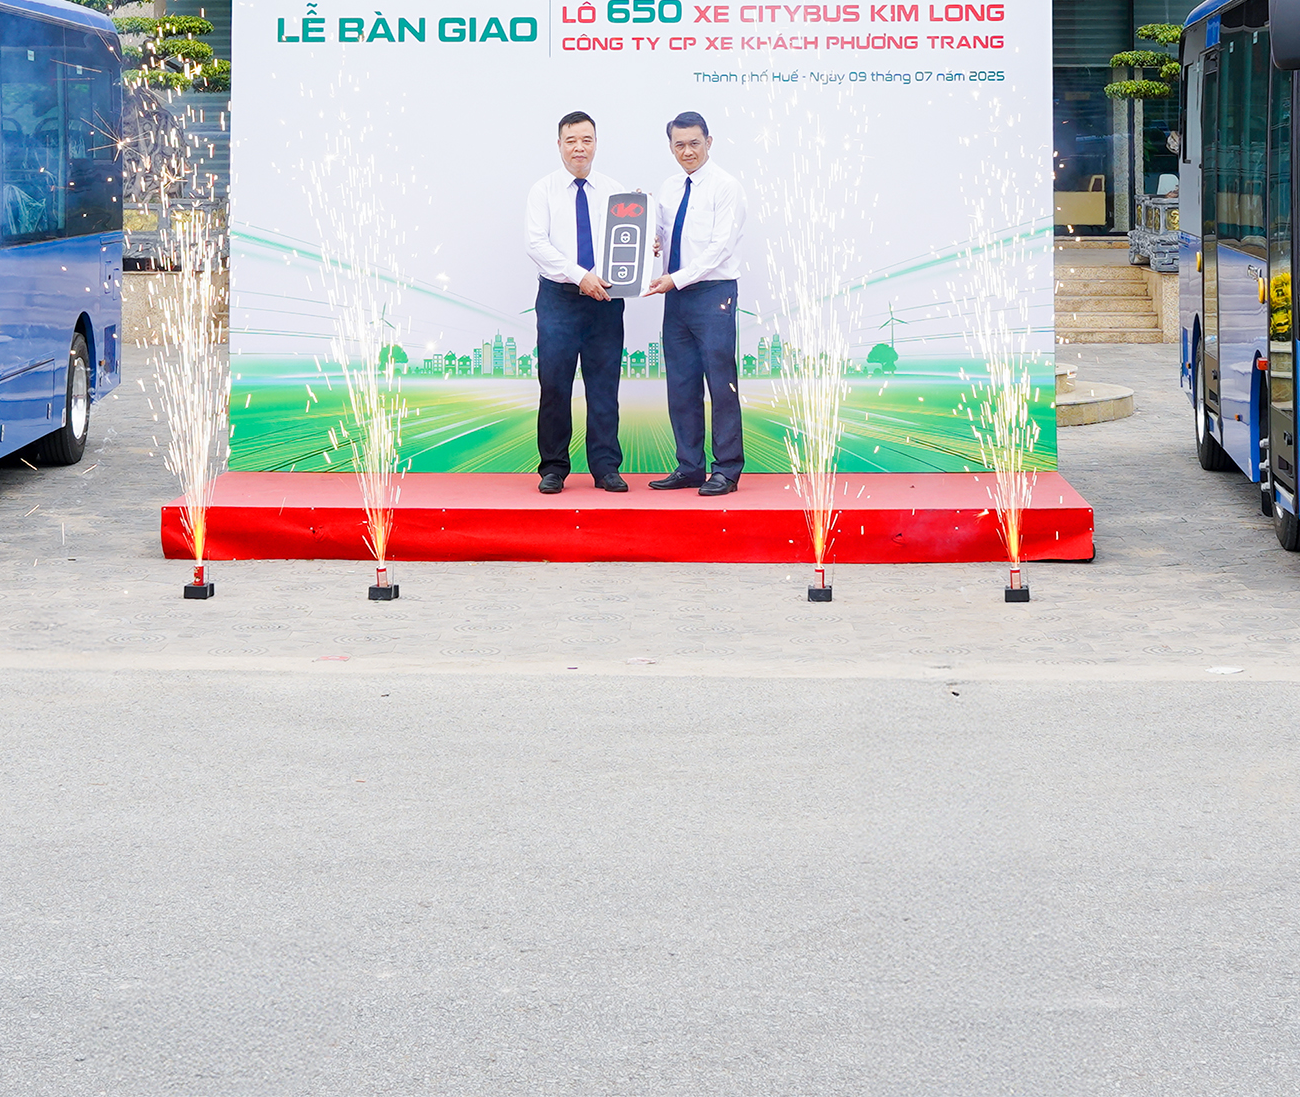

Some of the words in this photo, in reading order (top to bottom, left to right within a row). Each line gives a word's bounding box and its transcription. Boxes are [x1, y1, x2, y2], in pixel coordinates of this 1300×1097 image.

[562, 1, 597, 23] LÔ
[607, 0, 683, 24] 650
[693, 5, 730, 23] XE
[740, 4, 860, 23] CITYBUS
[870, 4, 919, 22] KIM
[929, 4, 1005, 22] LONG
[277, 2, 326, 43] LỄ
[338, 10, 426, 43] BÀN
[438, 16, 538, 43] GIAO
[562, 33, 624, 50] CÔNG
[631, 37, 661, 50] TY
[669, 37, 697, 50] CP
[705, 36, 733, 50] XE
[741, 33, 818, 50] KHÁCH
[826, 33, 919, 50] PHƯƠNG
[926, 35, 1005, 49] TRANG
[693, 70, 738, 83] Thành
[772, 69, 799, 83] Huế
[849, 71, 867, 82] 09
[870, 70, 911, 85] tháng
[914, 71, 933, 82] 07
[968, 71, 1006, 82] 2025
